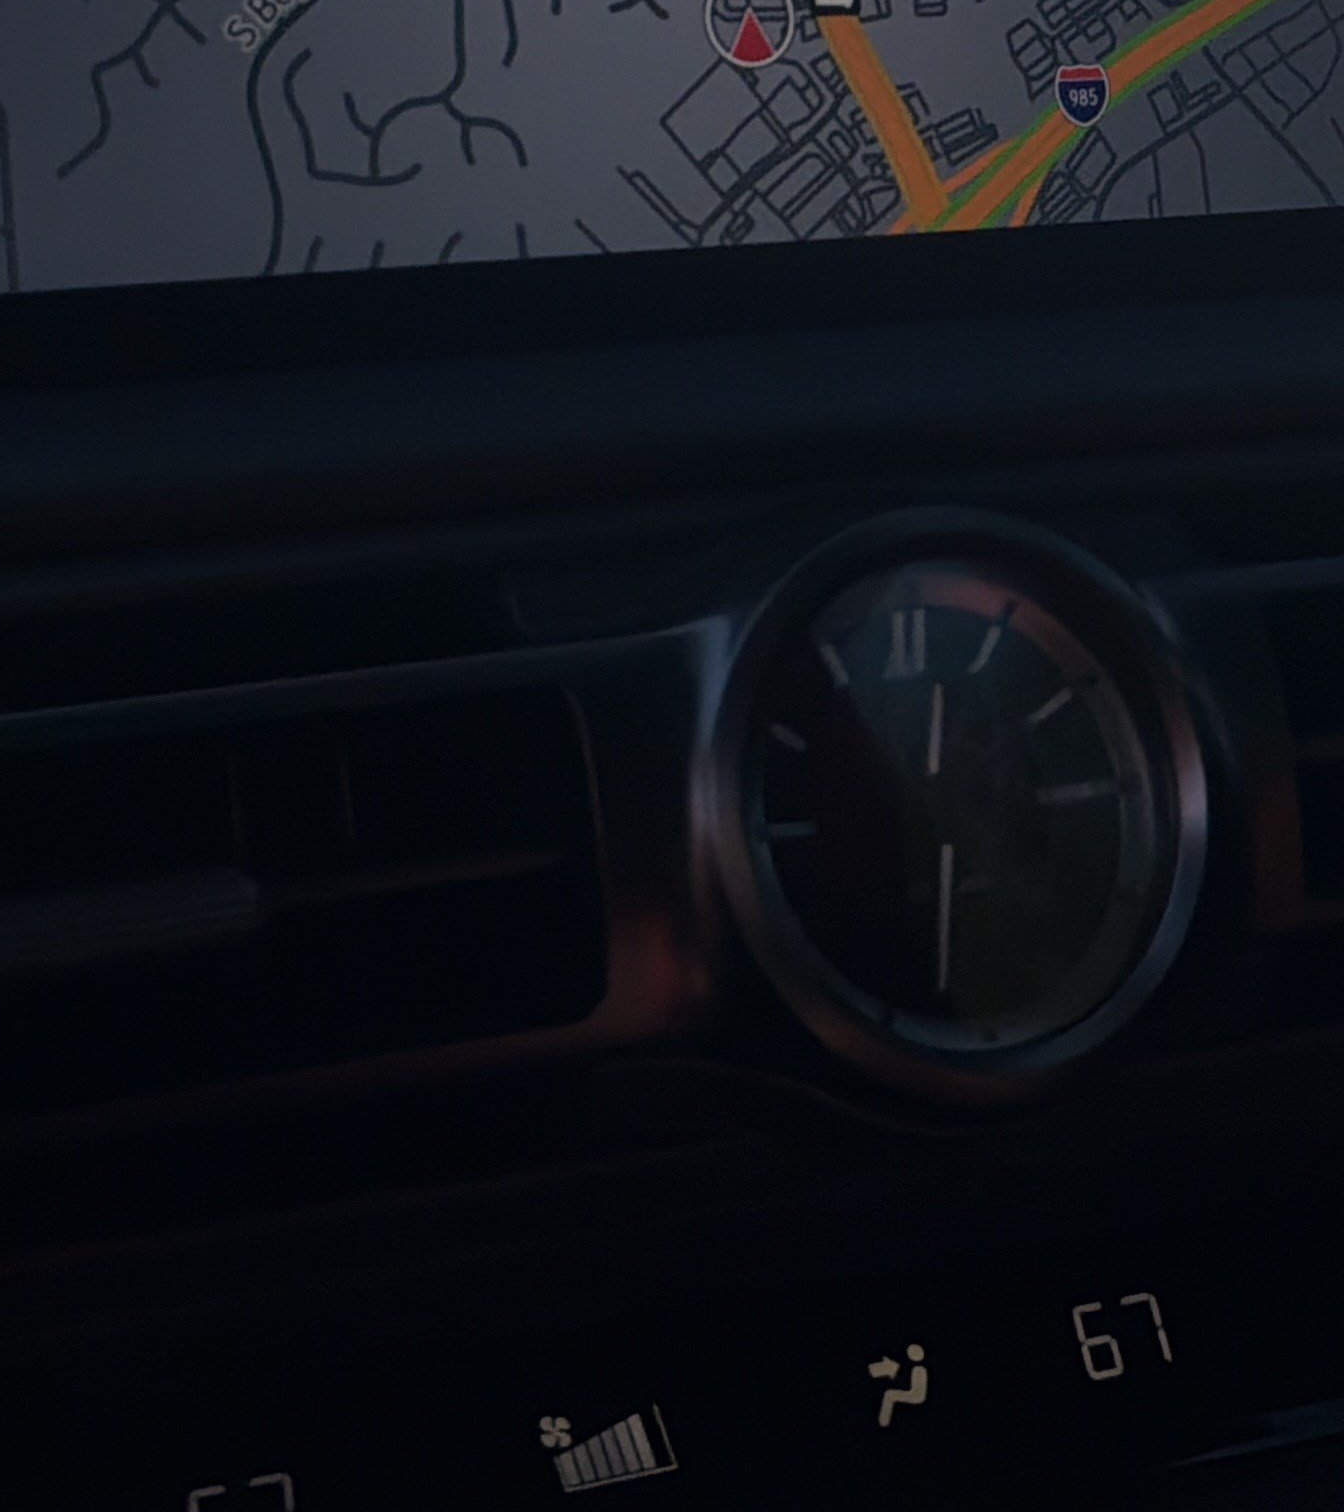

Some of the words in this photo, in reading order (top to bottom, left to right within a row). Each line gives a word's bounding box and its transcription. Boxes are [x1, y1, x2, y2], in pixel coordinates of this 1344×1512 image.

[226, 18, 257, 48] S
[1068, 87, 1099, 107] 985
[1072, 1292, 1173, 1381] 67
